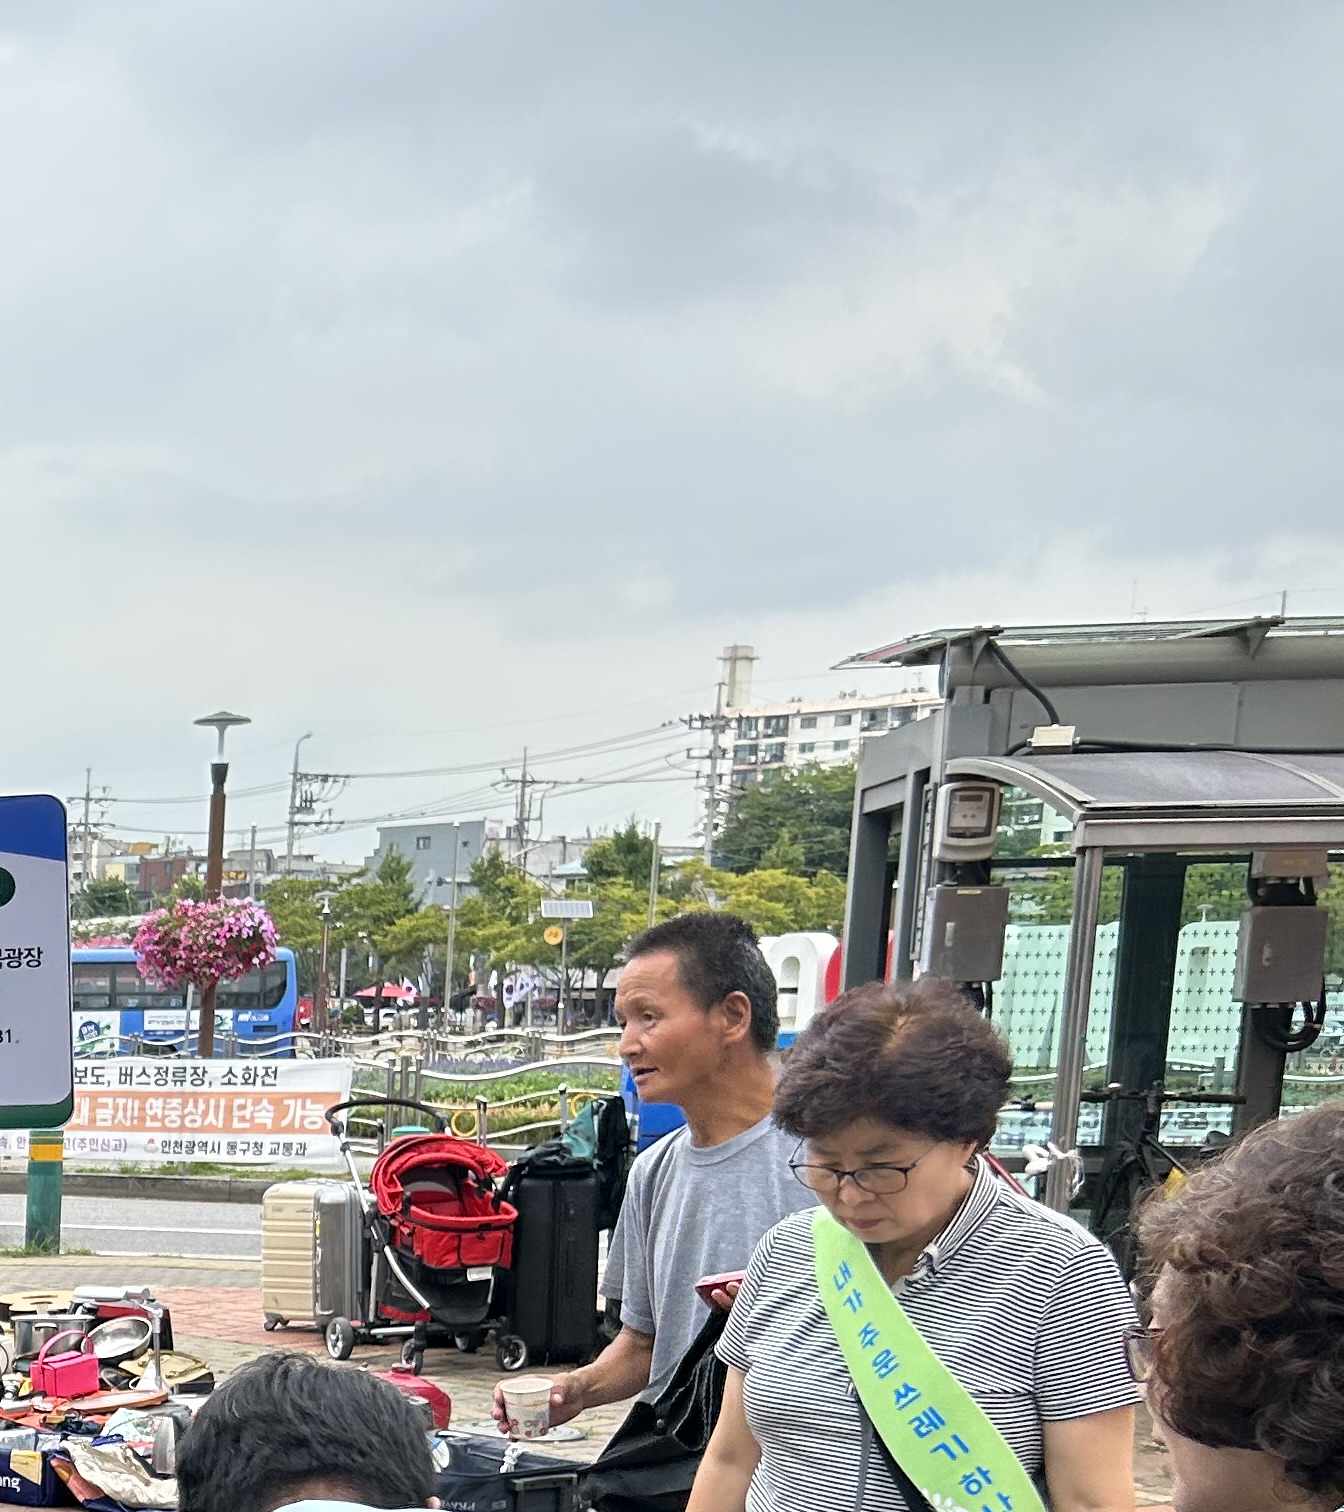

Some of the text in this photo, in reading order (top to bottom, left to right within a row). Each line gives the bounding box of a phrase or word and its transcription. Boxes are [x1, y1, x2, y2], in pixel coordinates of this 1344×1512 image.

[118, 1065, 213, 1088] 버스정류장,
[220, 1066, 278, 1088] 소화전
[144, 1097, 224, 1129] 연중상시
[232, 1097, 273, 1130] 단속
[281, 1097, 327, 1131] 가능
[161, 1140, 221, 1156] 인천광역시
[226, 1141, 264, 1157] 동구청
